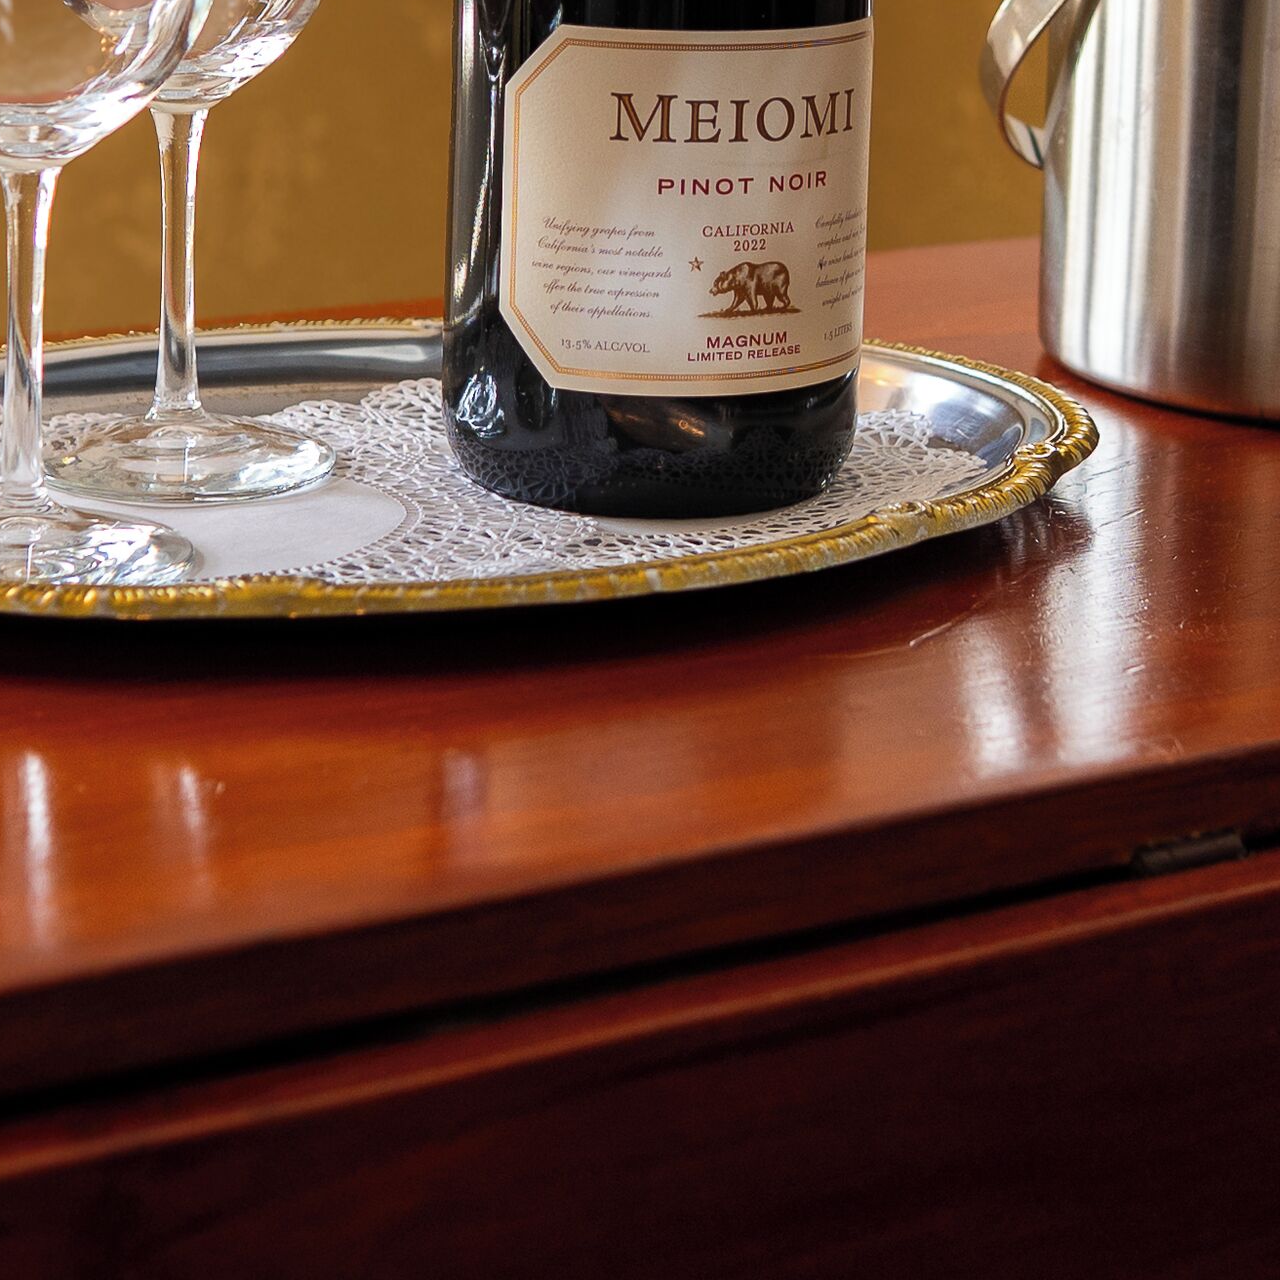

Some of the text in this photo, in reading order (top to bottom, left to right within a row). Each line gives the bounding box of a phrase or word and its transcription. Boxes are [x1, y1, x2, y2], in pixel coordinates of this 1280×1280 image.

[609, 88, 855, 144] MEIOMI
[657, 170, 827, 195] PINOT NOIR
[543, 216, 656, 240] Unifying grapes from
[702, 221, 795, 237] CALIFORNIA
[538, 236, 664, 258] California's most notable
[733, 238, 767, 252] 2022
[531, 260, 554, 270] wine
[596, 267, 616, 276] our
[618, 266, 673, 282] vineyards
[543, 278, 660, 300] offer the true expression
[550, 300, 563, 314] of
[562, 301, 585, 312] their
[561, 338, 651, 353] 13.5% ALC/VOL
[706, 331, 787, 349] MAGNUM
[687, 344, 801, 362] LIMITED RELEASE
